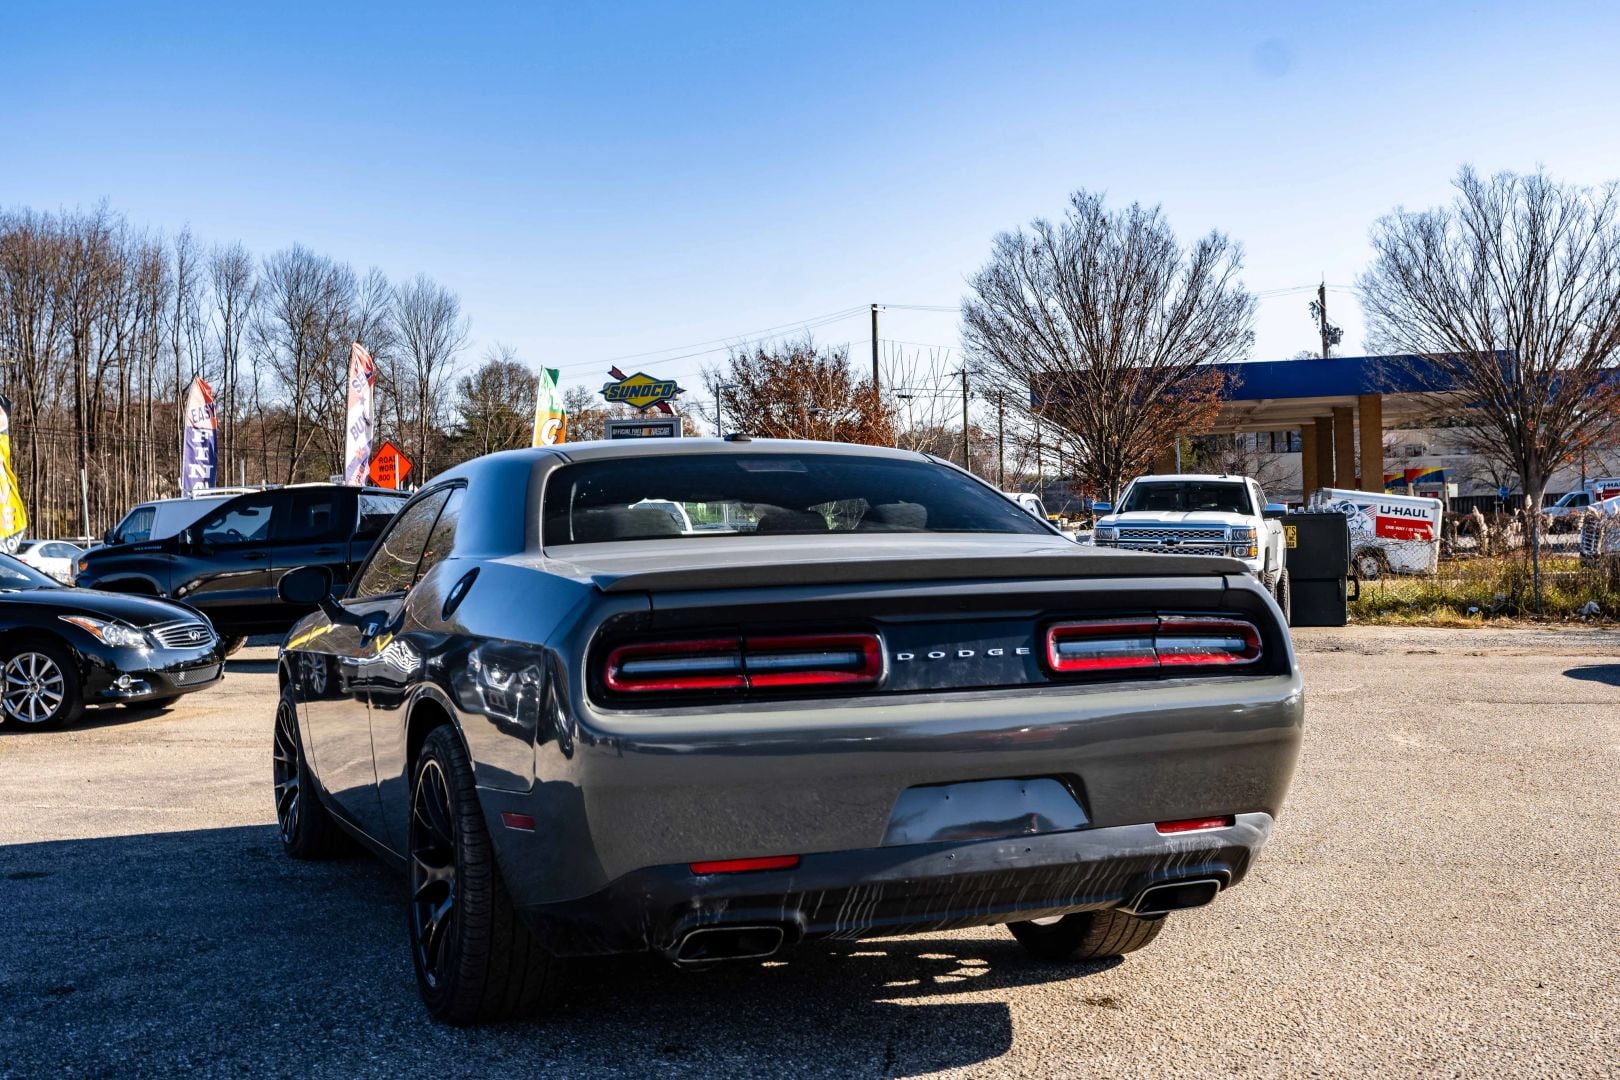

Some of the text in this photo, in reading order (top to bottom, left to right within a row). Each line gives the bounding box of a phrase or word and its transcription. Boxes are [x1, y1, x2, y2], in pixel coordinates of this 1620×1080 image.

[608, 384, 673, 399] SUNOCO
[191, 403, 216, 424] EASY
[350, 411, 371, 442] BUY
[379, 463, 396, 472] WOR
[1380, 505, 1428, 518] U-HAUL
[896, 647, 1031, 661] DODGE
